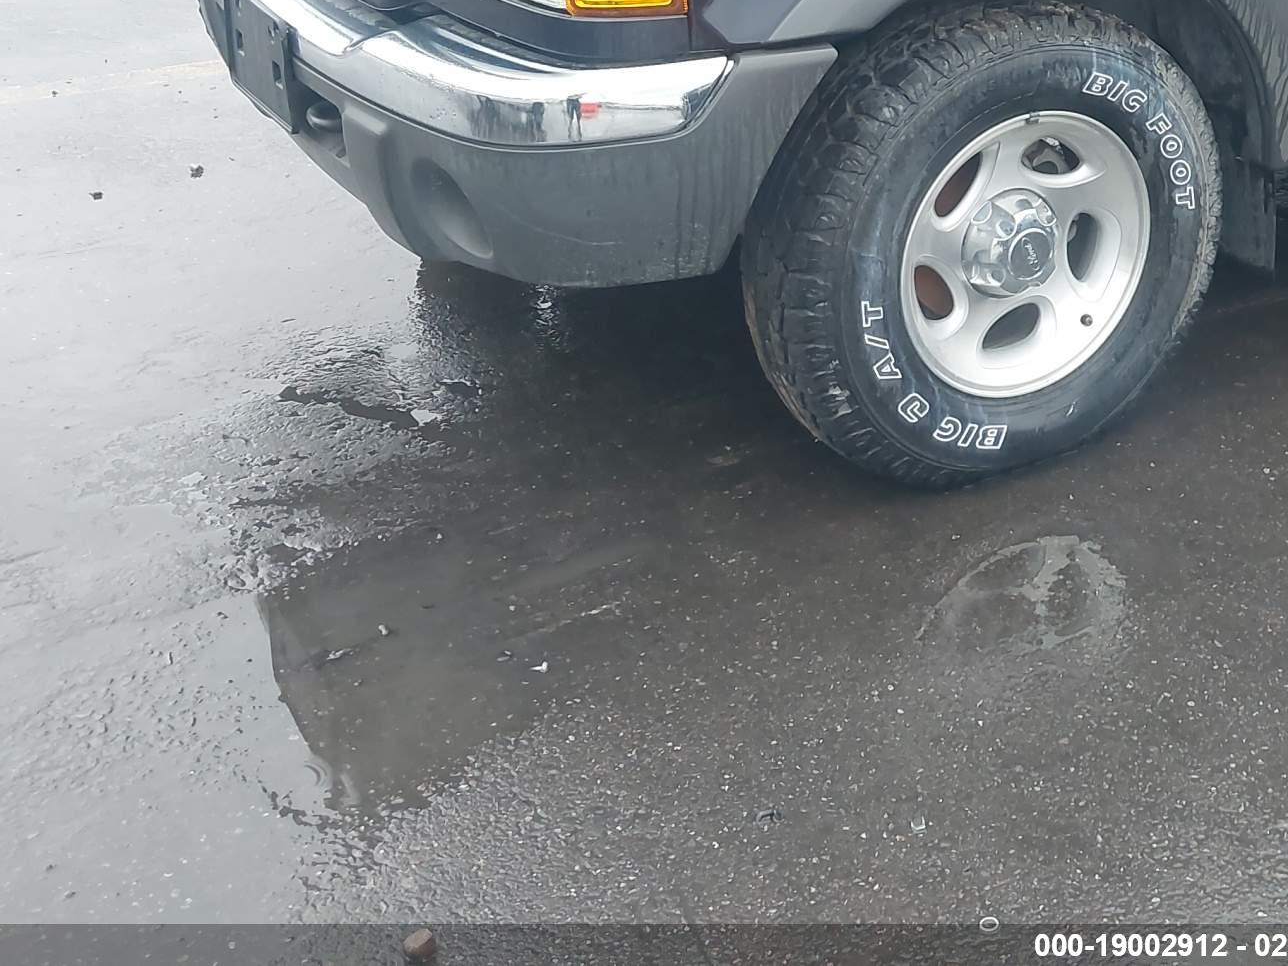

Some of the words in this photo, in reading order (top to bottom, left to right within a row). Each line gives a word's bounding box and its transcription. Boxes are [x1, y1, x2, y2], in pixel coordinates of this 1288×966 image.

[1082, 71, 1148, 113] BIG
[1145, 112, 1196, 210] FOOT
[860, 300, 903, 380] A/T
[932, 416, 1008, 450] BIG
